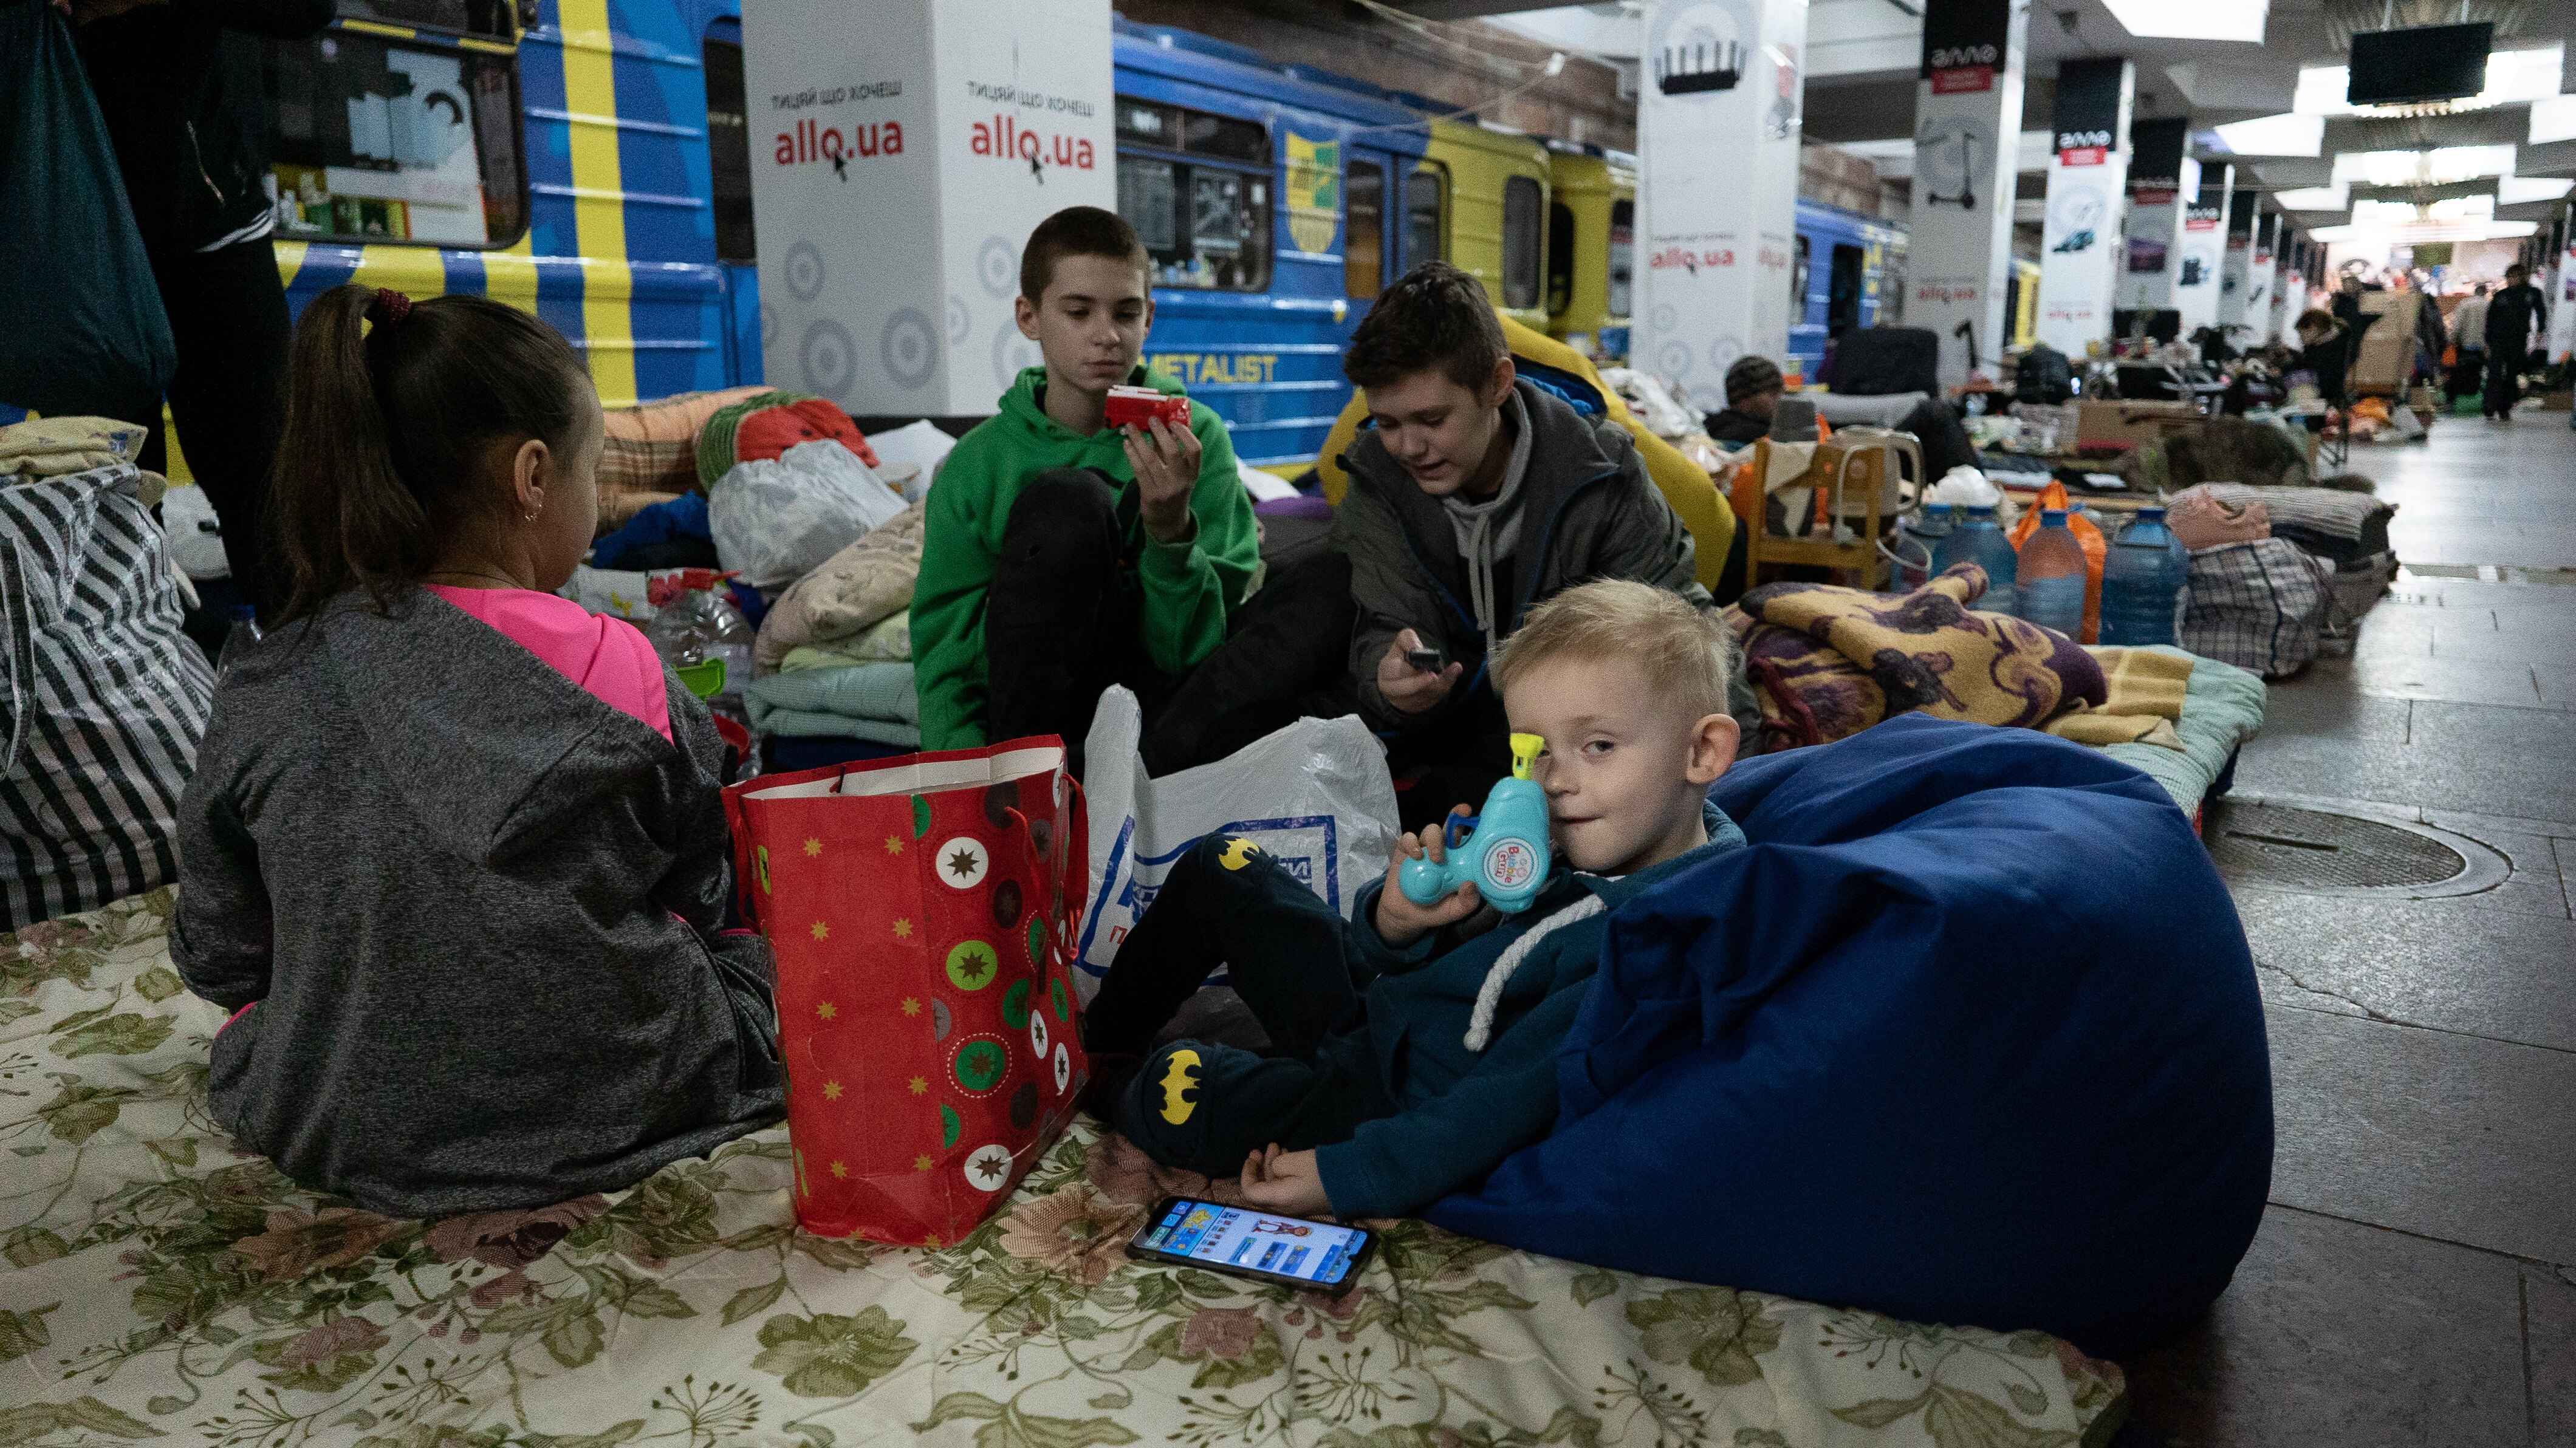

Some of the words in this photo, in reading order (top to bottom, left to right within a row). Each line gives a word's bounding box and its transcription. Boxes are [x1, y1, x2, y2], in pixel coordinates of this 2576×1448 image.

[772, 87, 818, 109] ТИЦЯЙ
[820, 87, 846, 106] ЩО
[849, 81, 902, 101] ХОЧЕШ
[967, 80, 1016, 103] ТИЦЯЙ
[1018, 90, 1044, 109] ЩО
[1046, 96, 1094, 117] ХОЧЕШ
[775, 120, 903, 165] allo.ua
[971, 114, 1094, 169] allo.ua
[1649, 248, 1736, 268] allo.ua
[1495, 851, 1509, 878] Gun
